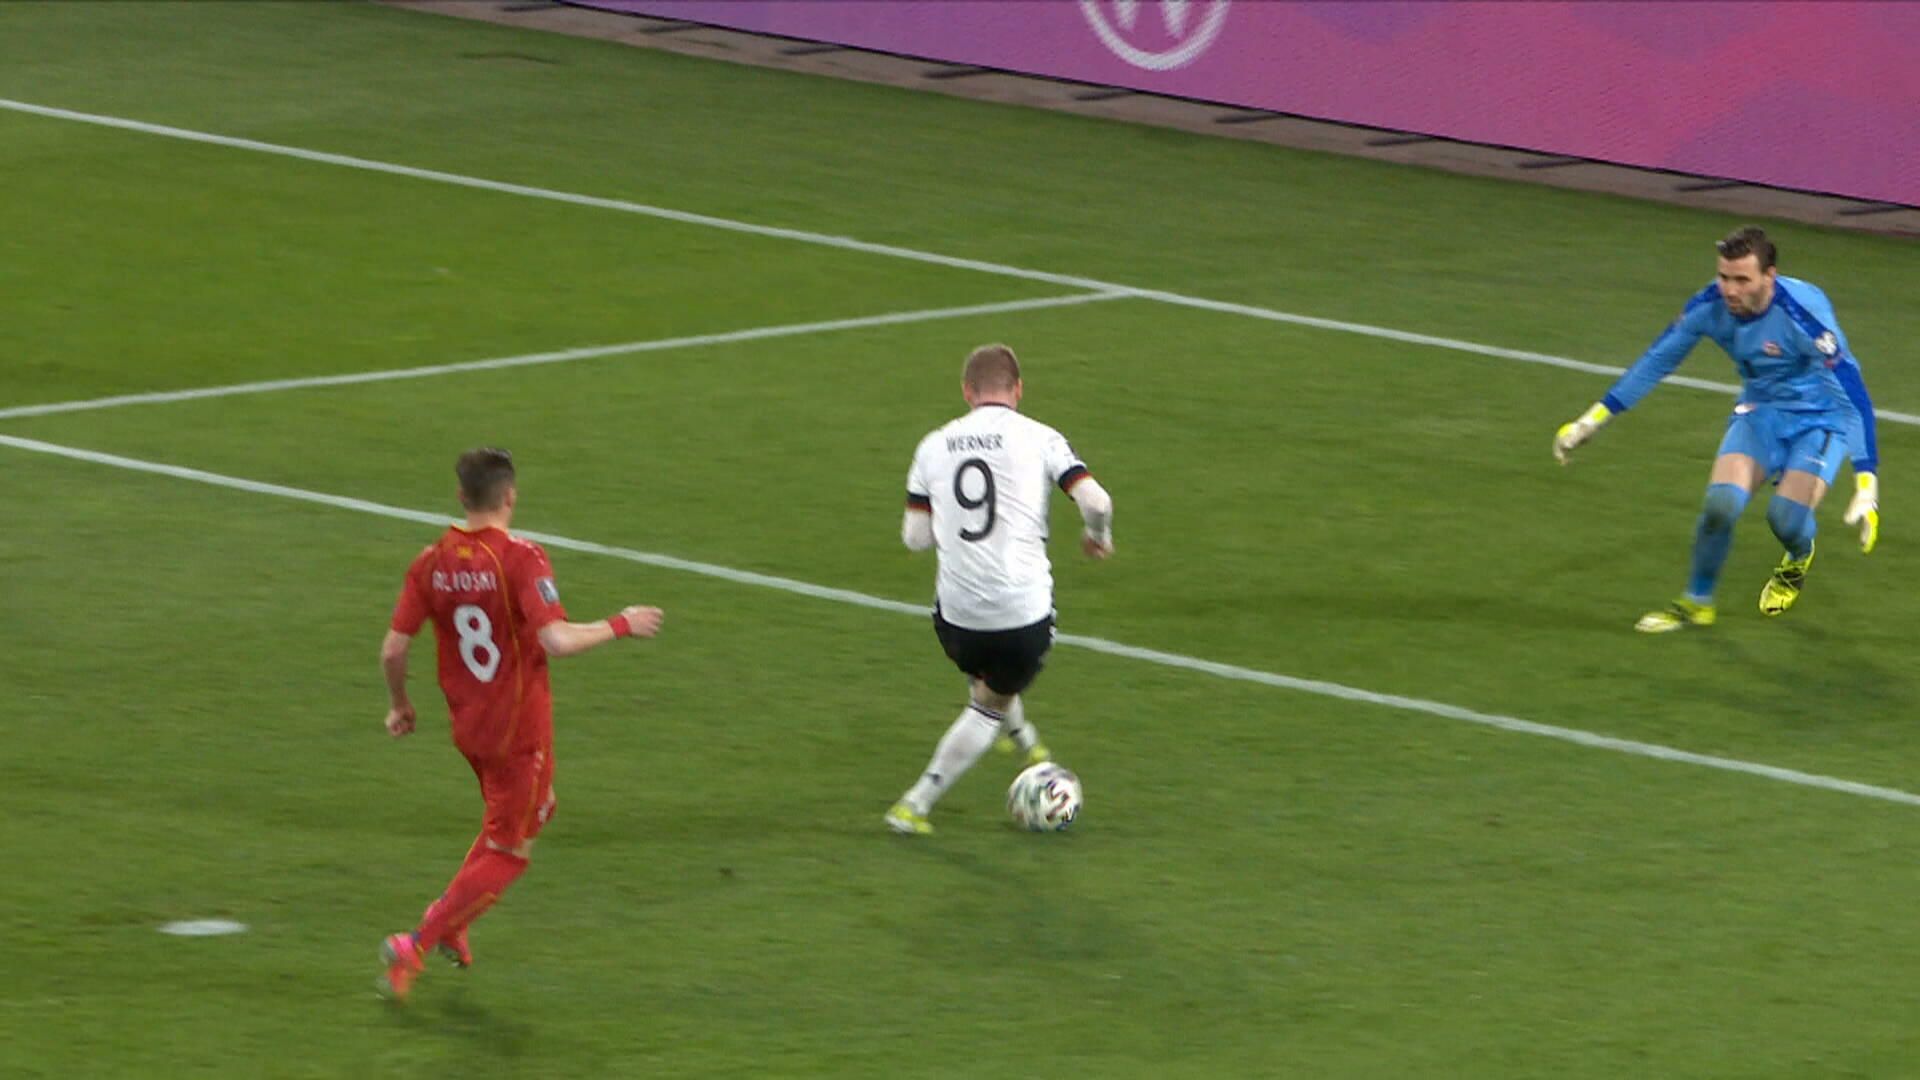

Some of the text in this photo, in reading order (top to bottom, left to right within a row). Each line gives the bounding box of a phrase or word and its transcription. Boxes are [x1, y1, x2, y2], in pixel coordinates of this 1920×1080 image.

[946, 434, 1003, 452] WERNER
[953, 457, 996, 542] 9
[454, 604, 502, 683] 8
